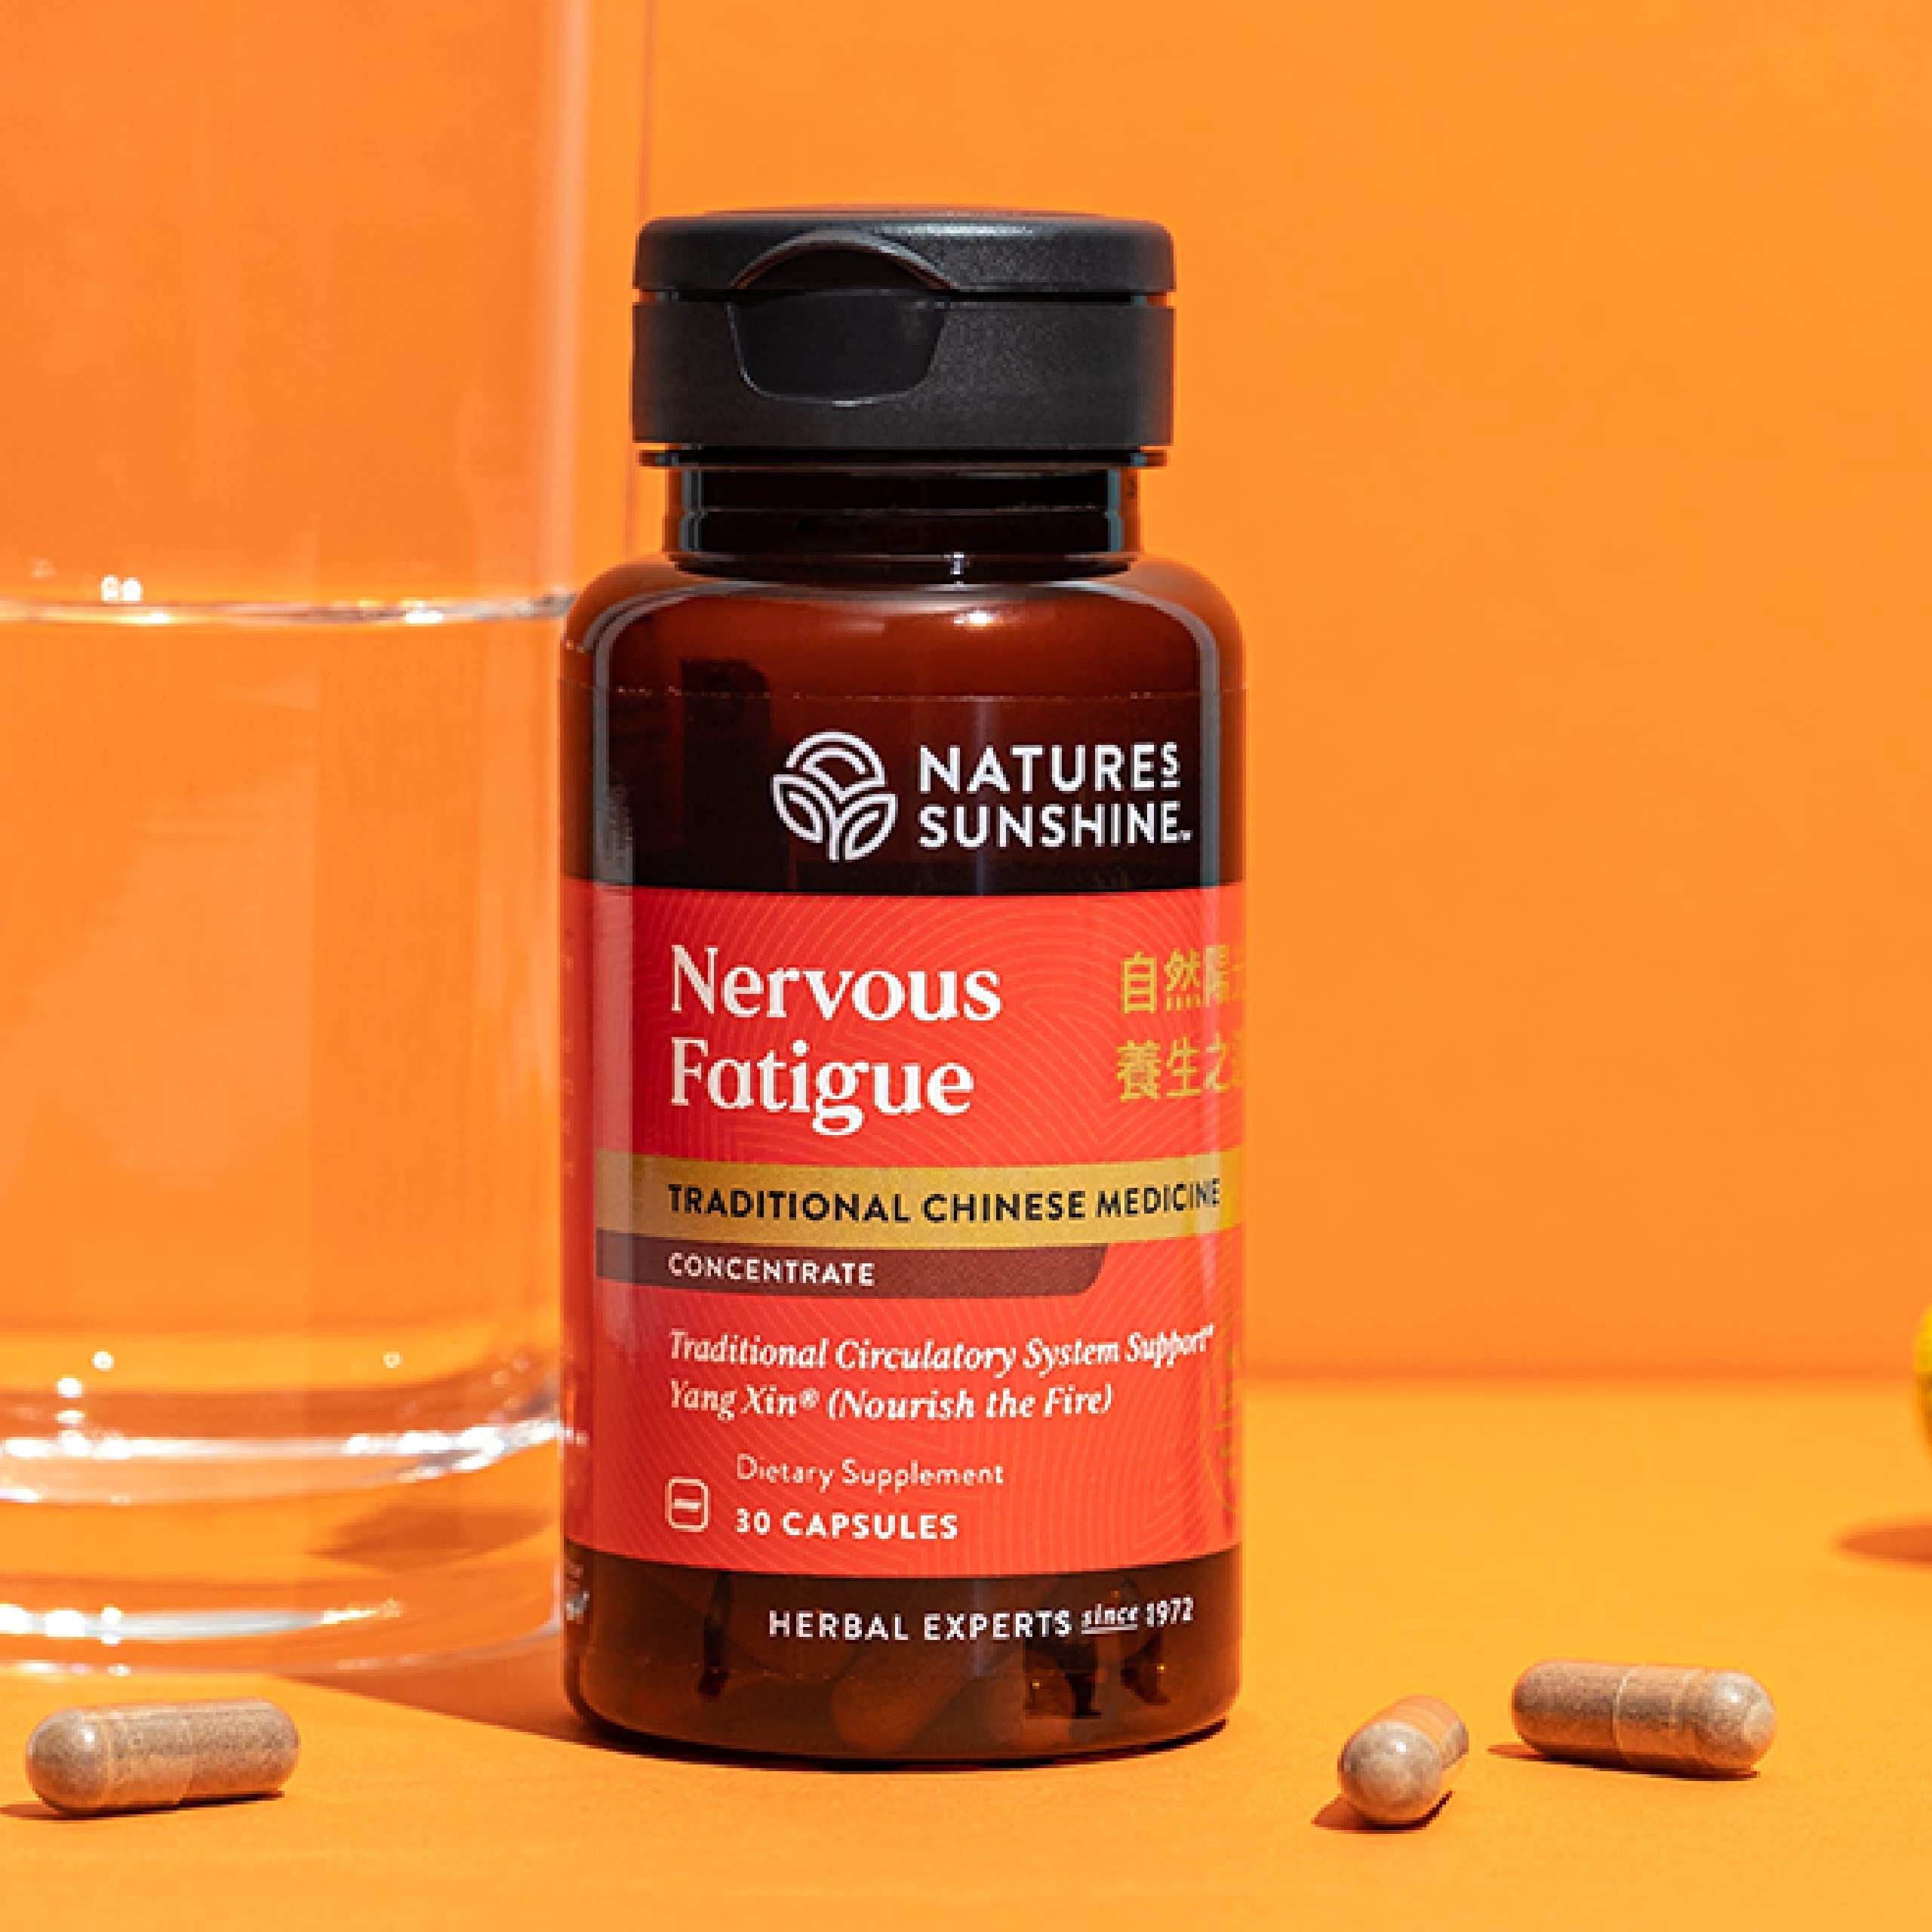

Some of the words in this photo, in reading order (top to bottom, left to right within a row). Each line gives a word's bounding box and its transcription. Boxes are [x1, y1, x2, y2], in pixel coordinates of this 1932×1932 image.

[918, 741, 1180, 793] NATURES
[670, 944, 1004, 1021] Nervous
[670, 1036, 975, 1137] Fatigue
[667, 1183, 910, 1224] TRADITIONAL
[921, 1190, 1086, 1225] CHINESE
[1096, 1177, 1220, 1218] MEDICINE
[667, 1252, 875, 1287] CONCENTRATE
[669, 1327, 829, 1370] Traditional
[835, 1337, 1017, 1379] Circulatory
[1022, 1337, 1119, 1380] System
[669, 1377, 738, 1421] Yang
[827, 1386, 975, 1421] (Nourish
[986, 1387, 1036, 1419] the
[1043, 1382, 1112, 1419] Fire)
[736, 1452, 834, 1494] Dietary
[841, 1456, 1004, 1496] Supplement
[734, 1506, 771, 1536] 30
[782, 1512, 958, 1540] CAPSULES
[768, 1610, 909, 1641] HERBAL
[923, 1609, 1071, 1641] EXPERTS
[1081, 1601, 1140, 1632] since
[1146, 1594, 1195, 1629] 1972
